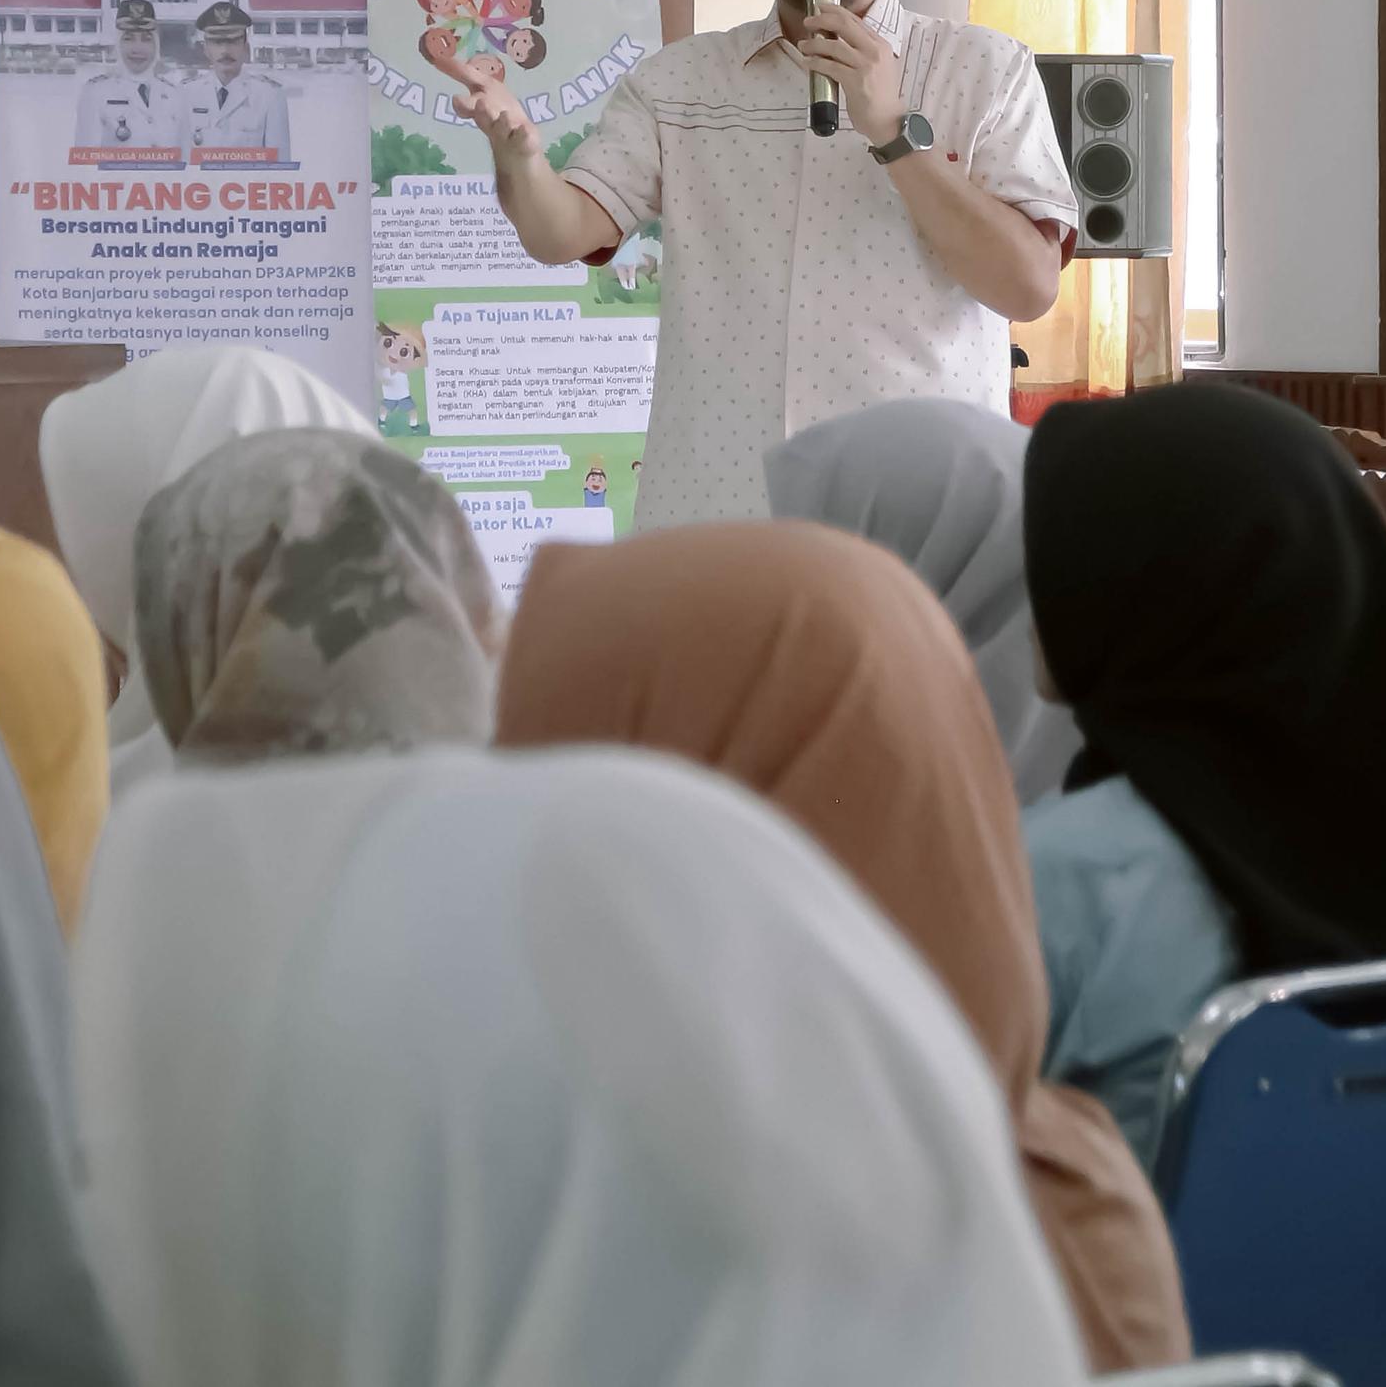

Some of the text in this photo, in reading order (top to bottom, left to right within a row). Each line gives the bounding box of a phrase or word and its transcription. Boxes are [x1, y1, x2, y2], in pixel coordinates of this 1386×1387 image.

[367, 51, 425, 115] OTA
[560, 33, 645, 115] ANAK
[400, 182, 435, 197] Apa
[439, 182, 463, 195] itu
[41, 216, 326, 238] Bersama Lindungi Tangani
[458, 229, 473, 237] dan
[476, 229, 516, 237] sumberda
[399, 241, 414, 249] dan
[91, 242, 278, 262] Anak dan Remaja
[398, 252, 413, 260] dan
[373, 264, 404, 272] egiatan
[14, 266, 356, 285] merupakan proyek perubahan DP3APMP2KB
[23, 285, 348, 303] Kota Banjarbaru sebagai respon terhadap
[18, 305, 353, 323] meningkatnya kekerasan anak dan remaja
[441, 308, 574, 325] Apa Tujuan KLA?
[44, 325, 329, 342] serta terbatasnya layanan konseling
[433, 337, 461, 345] Secara
[501, 336, 525, 344] Untuk
[434, 348, 479, 357] melindungi
[435, 368, 463, 376] Secara
[537, 366, 588, 376] membangun
[594, 365, 655, 375] Kabupaten/Kot
[437, 380, 456, 389] yang
[458, 379, 499, 388] mengarah
[501, 378, 522, 387] pada
[525, 378, 549, 387] upaya
[552, 377, 603, 385] transformasi
[607, 376, 643, 384] Konvensi
[437, 390, 457, 398] Anak
[493, 389, 518, 397] dalam
[438, 402, 473, 411] kegiatan
[485, 401, 543, 410] pembangunan
[557, 400, 576, 408] yang
[588, 398, 626, 407] ditujukan
[438, 413, 487, 422] pemenuhan
[488, 412, 504, 420] hak
[522, 411, 577, 420] perlindungan
[461, 498, 526, 514] Apa saja
[513, 517, 553, 530] KLA?
